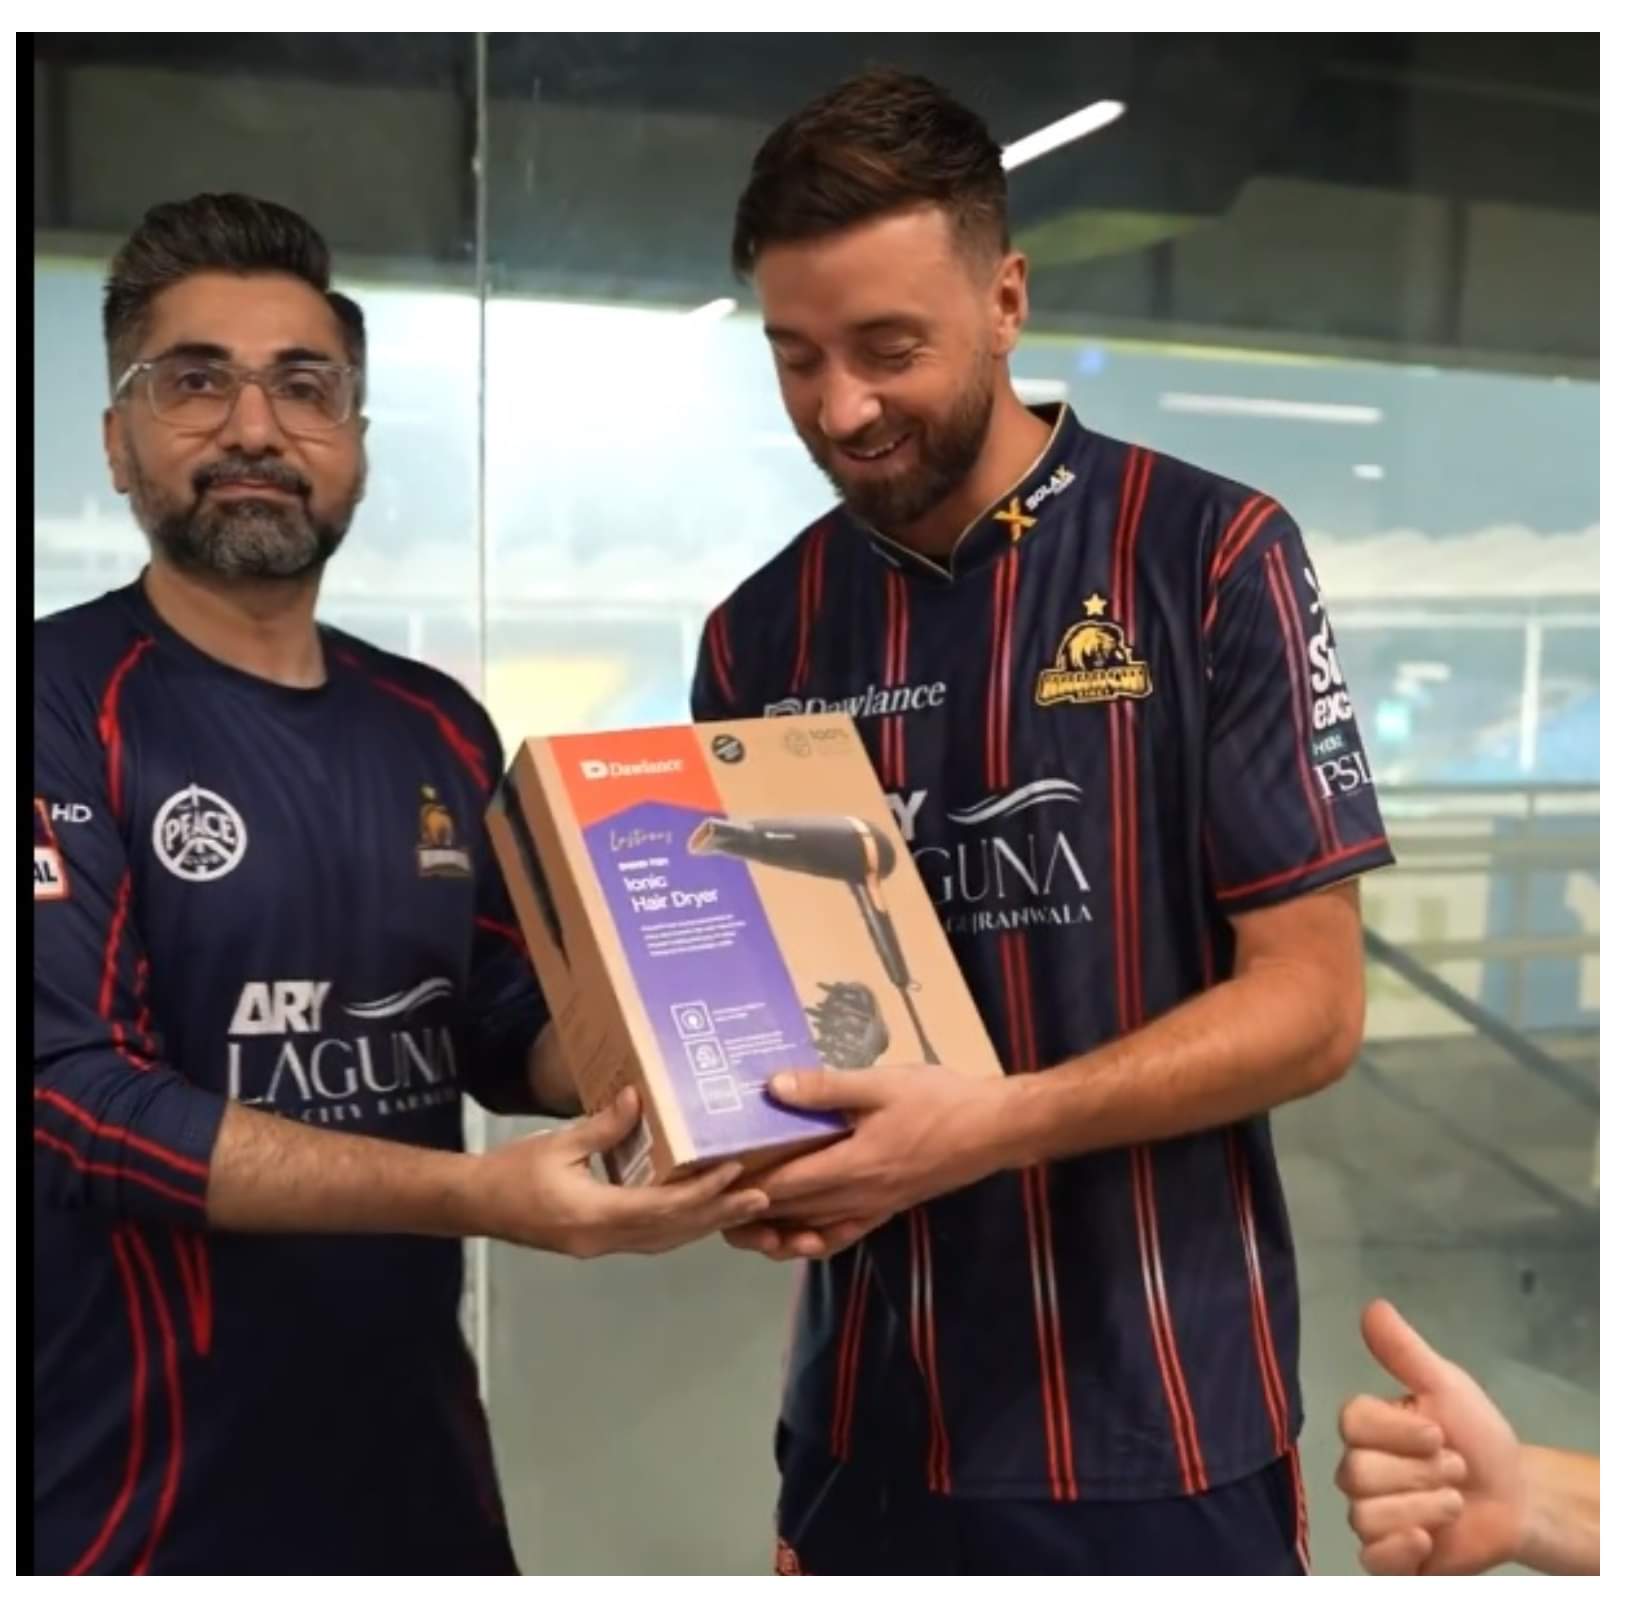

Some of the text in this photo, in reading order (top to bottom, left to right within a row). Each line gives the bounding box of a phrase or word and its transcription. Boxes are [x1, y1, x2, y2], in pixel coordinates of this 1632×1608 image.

[52, 802, 94, 822] HD
[166, 810, 236, 851] PEACE
[913, 830, 1090, 903] GUNA
[632, 888, 719, 913] Hair Dryer
[227, 980, 333, 1035] ARY
